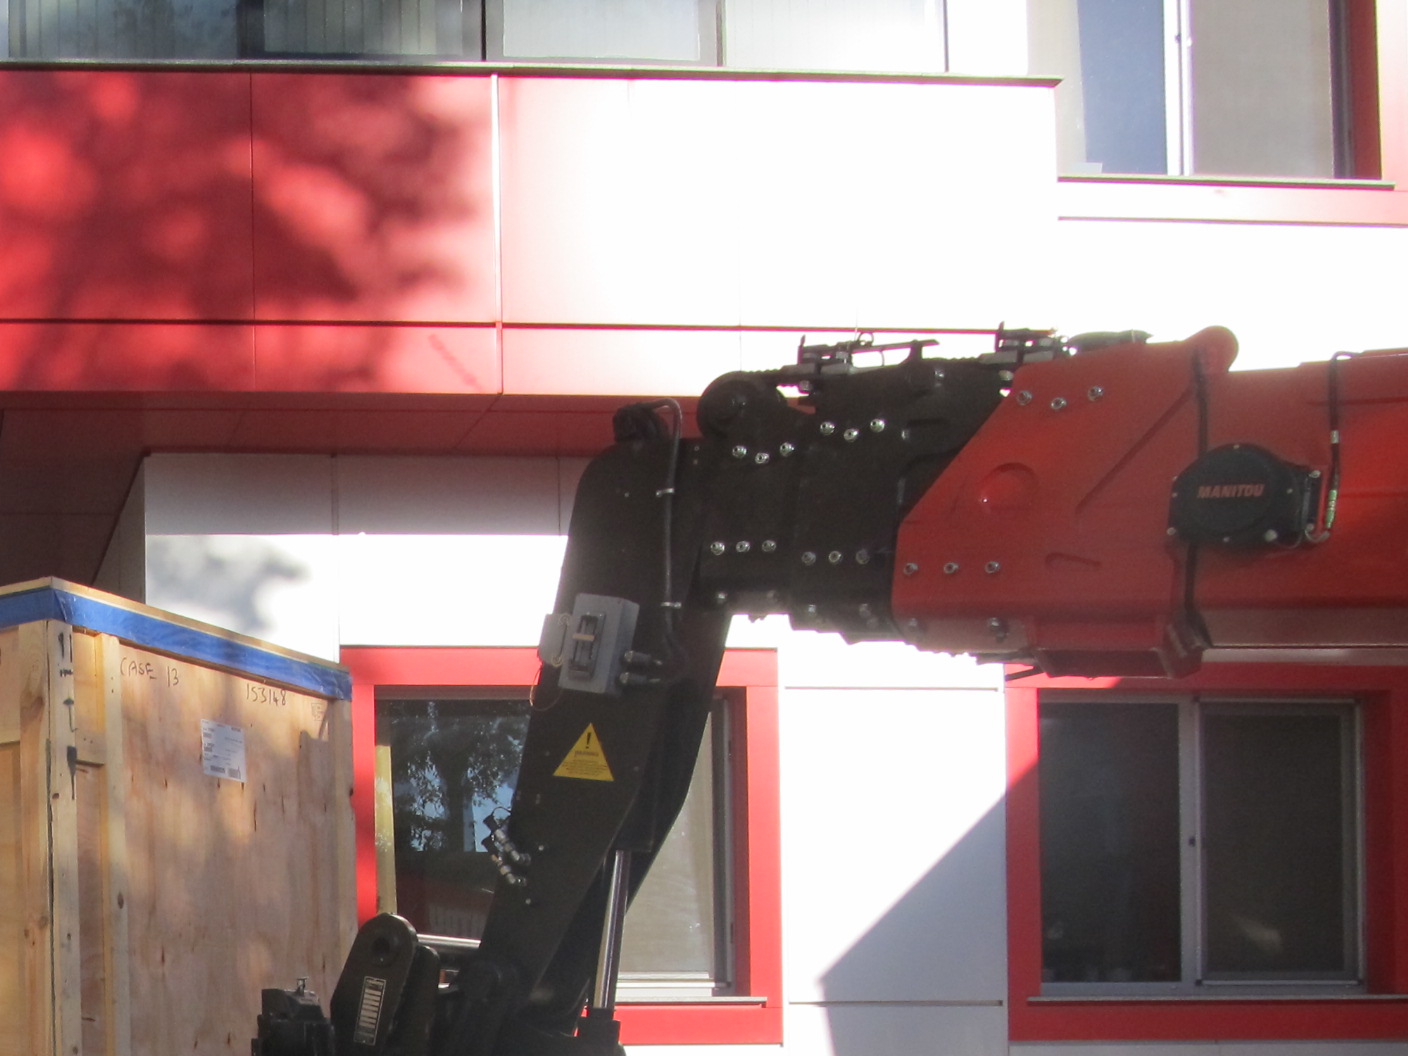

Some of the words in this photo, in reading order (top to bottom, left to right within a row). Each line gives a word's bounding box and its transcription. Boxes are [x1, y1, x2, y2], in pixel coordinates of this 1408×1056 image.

[1197, 484, 1265, 498] MANITOU
[120, 658, 157, 680] CASE
[167, 666, 180, 687] 13
[246, 683, 287, 706] 153148
